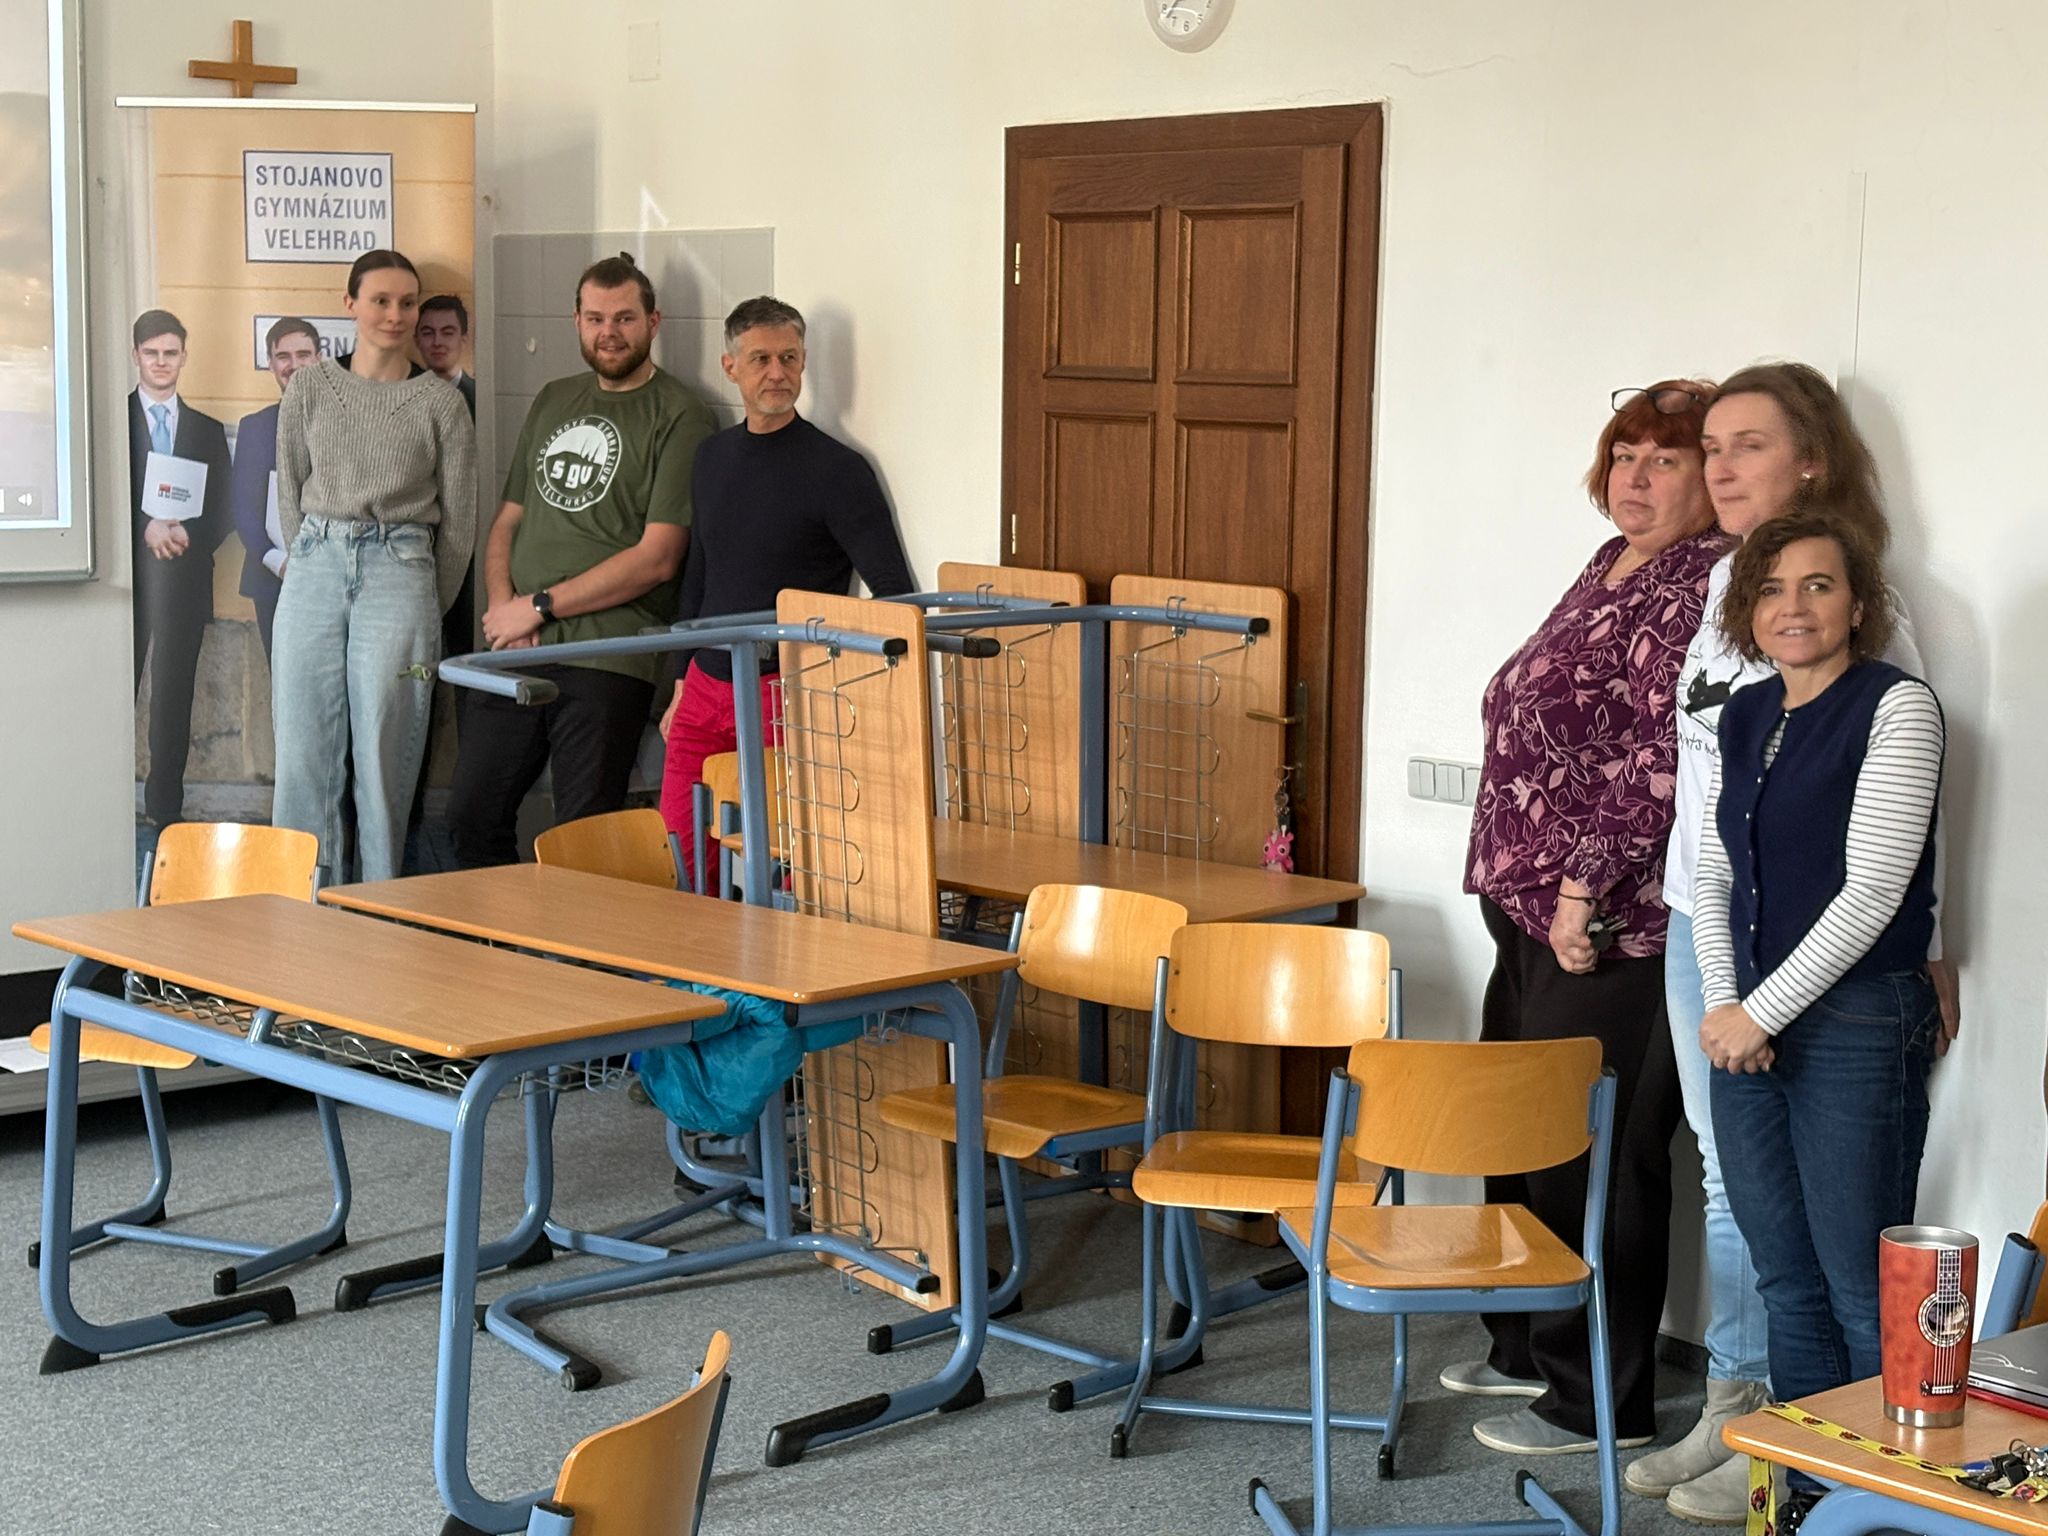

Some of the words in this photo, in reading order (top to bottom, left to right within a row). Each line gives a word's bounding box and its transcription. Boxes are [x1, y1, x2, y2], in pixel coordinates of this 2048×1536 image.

[255, 164, 383, 189] STOJANOVO
[253, 192, 387, 220] GYMNÁZIUM
[264, 228, 377, 251] VELEHRAD
[536, 418, 586, 473] STOJANOVO
[541, 482, 595, 507] VELEHRAD
